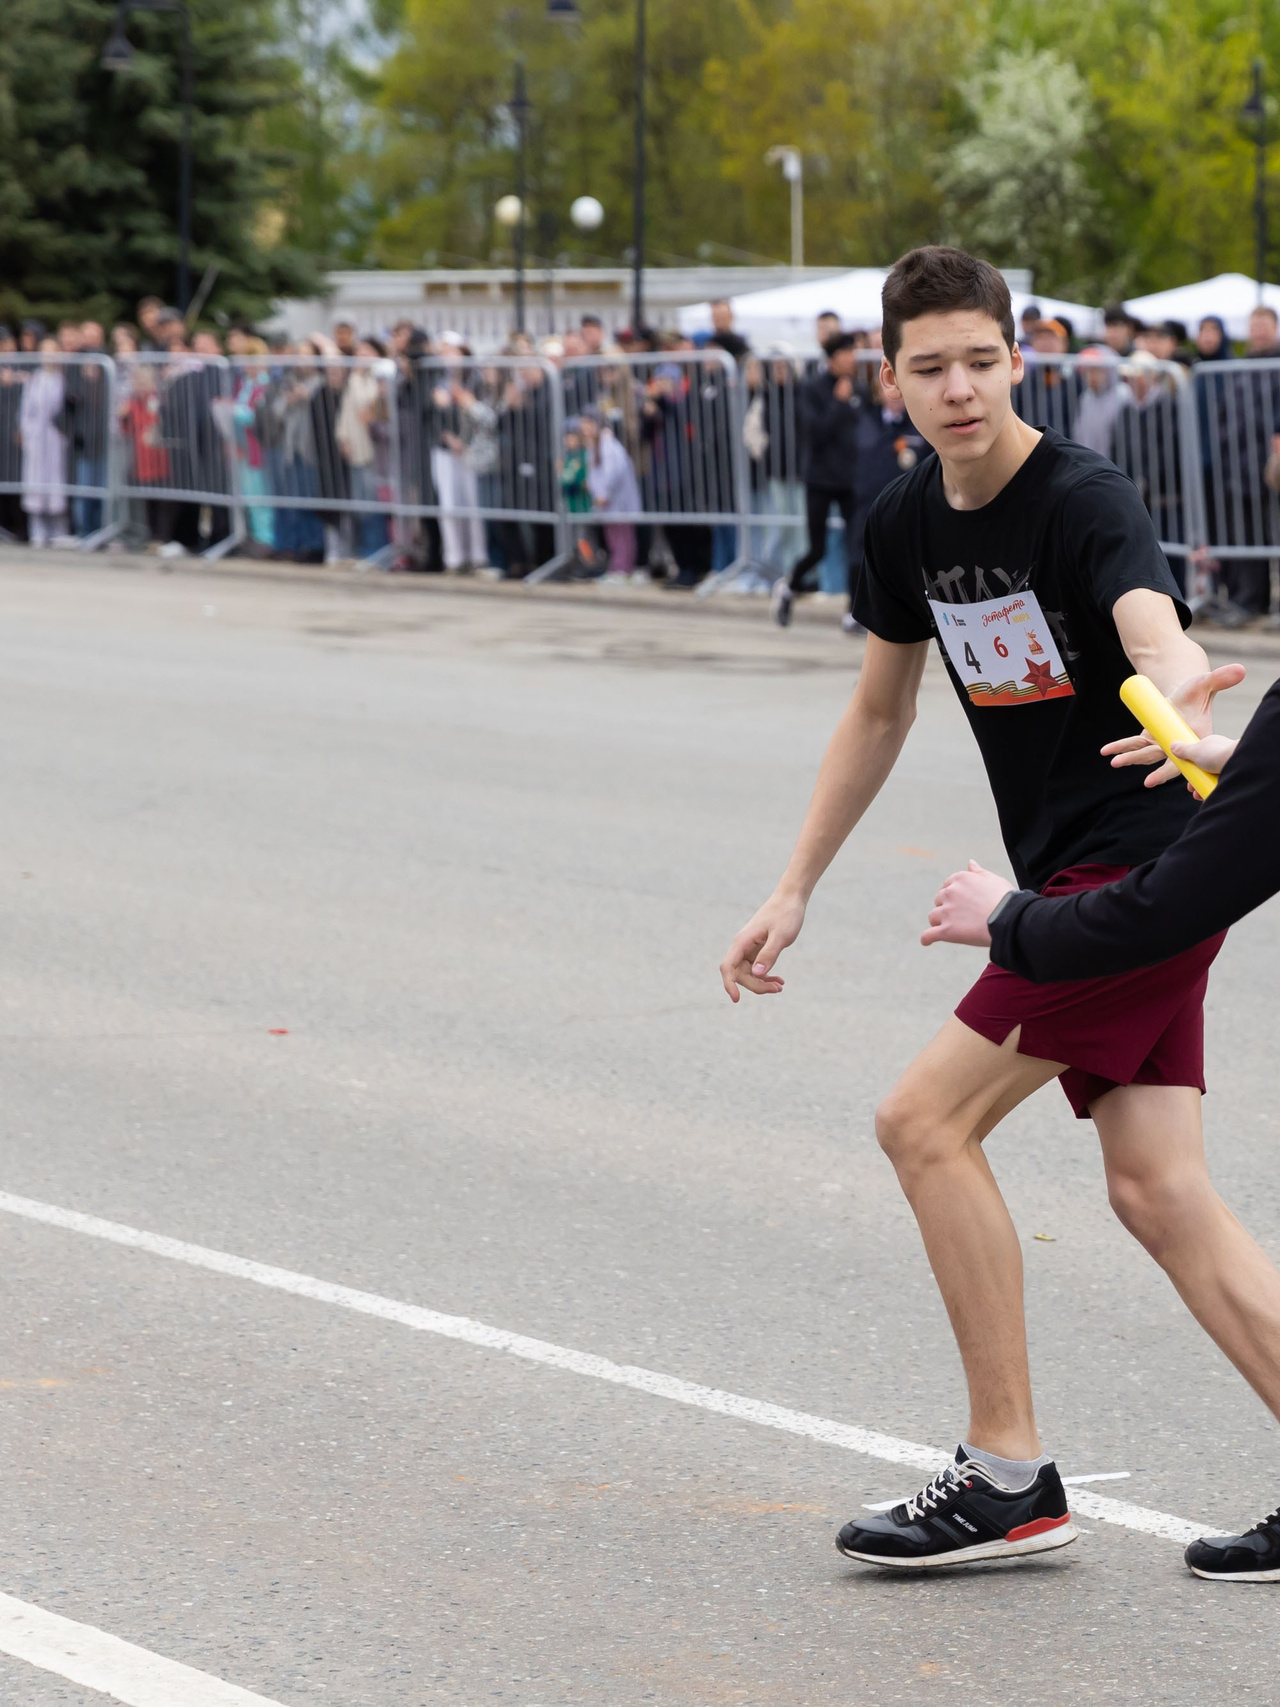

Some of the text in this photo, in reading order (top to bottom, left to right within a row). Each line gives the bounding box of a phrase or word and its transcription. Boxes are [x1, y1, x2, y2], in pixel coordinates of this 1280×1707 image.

[981, 599, 1026, 628] Эстафета
[963, 641, 983, 674] 4
[993, 635, 1009, 658] 6
